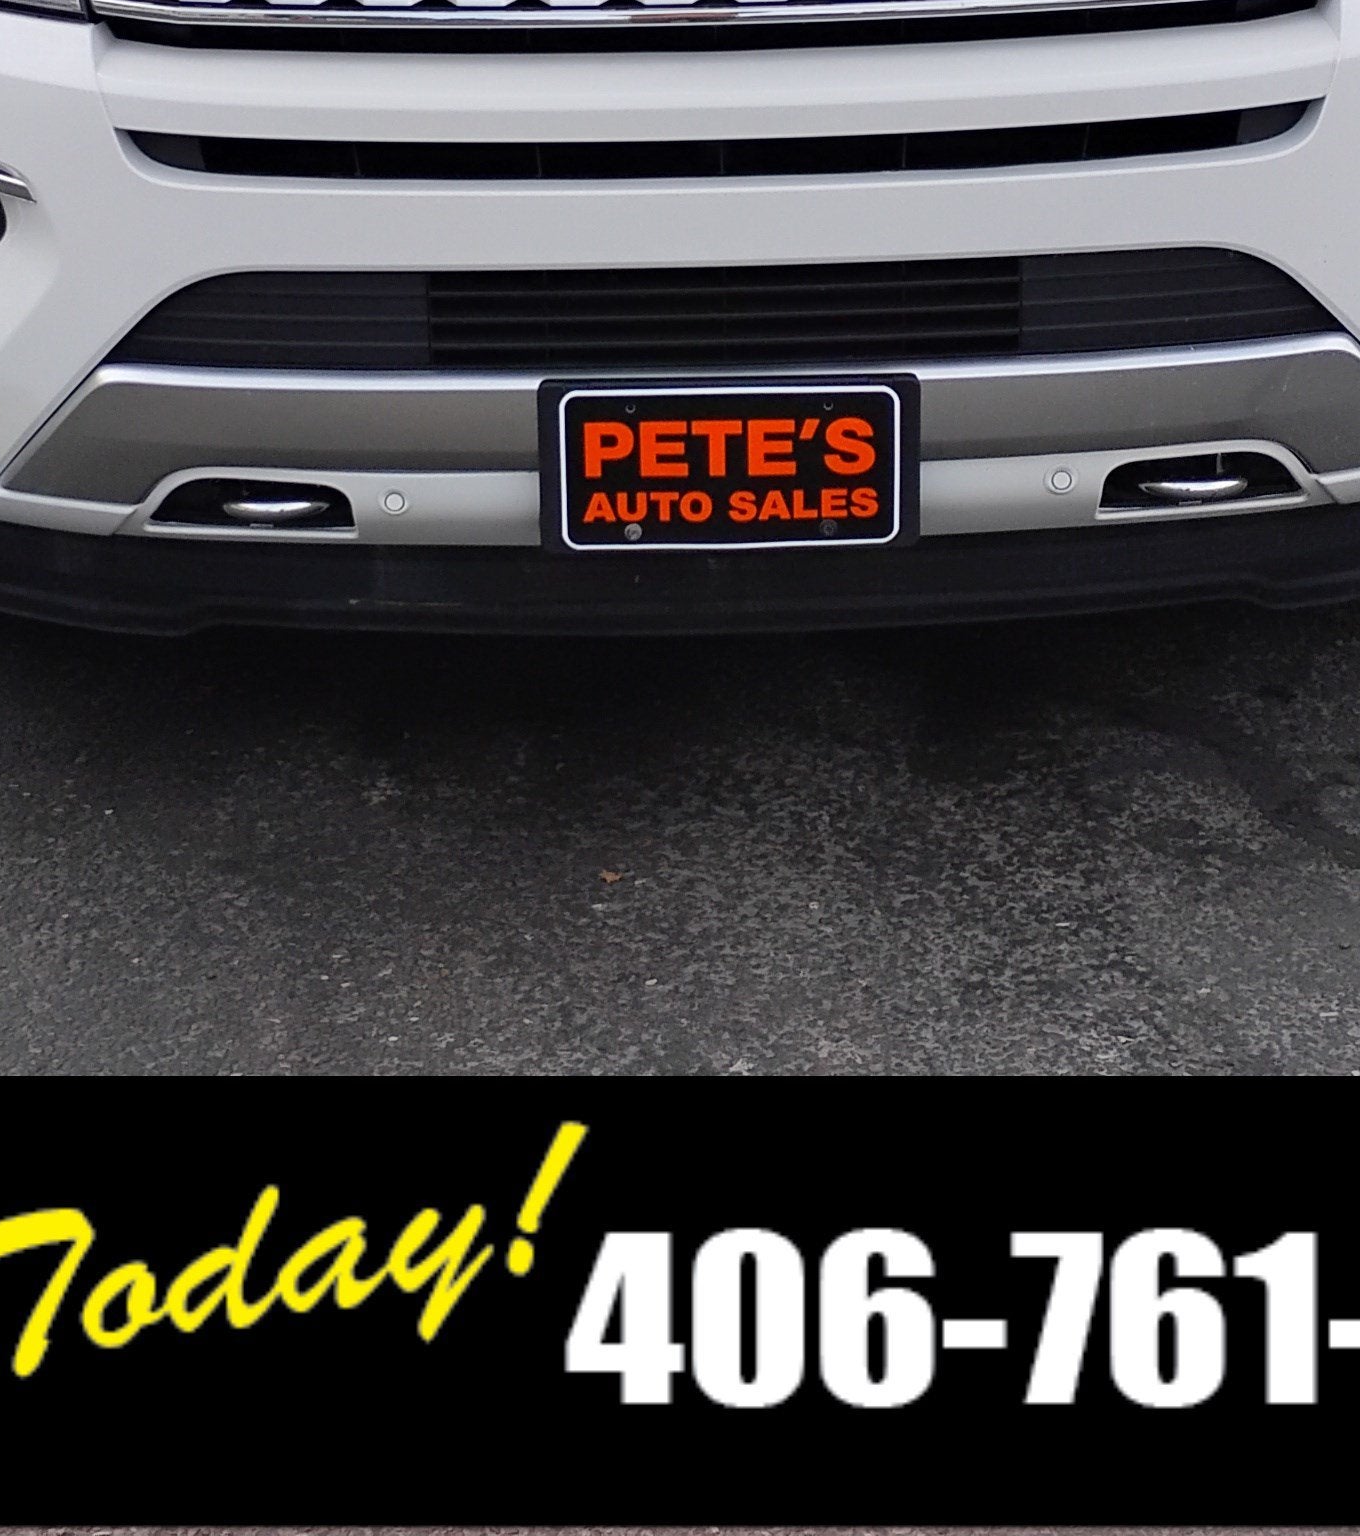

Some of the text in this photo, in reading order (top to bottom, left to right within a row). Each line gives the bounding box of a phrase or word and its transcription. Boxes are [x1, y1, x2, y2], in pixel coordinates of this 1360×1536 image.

[583, 417, 876, 478] PETE'S
[583, 487, 879, 523] AUTO SALES
